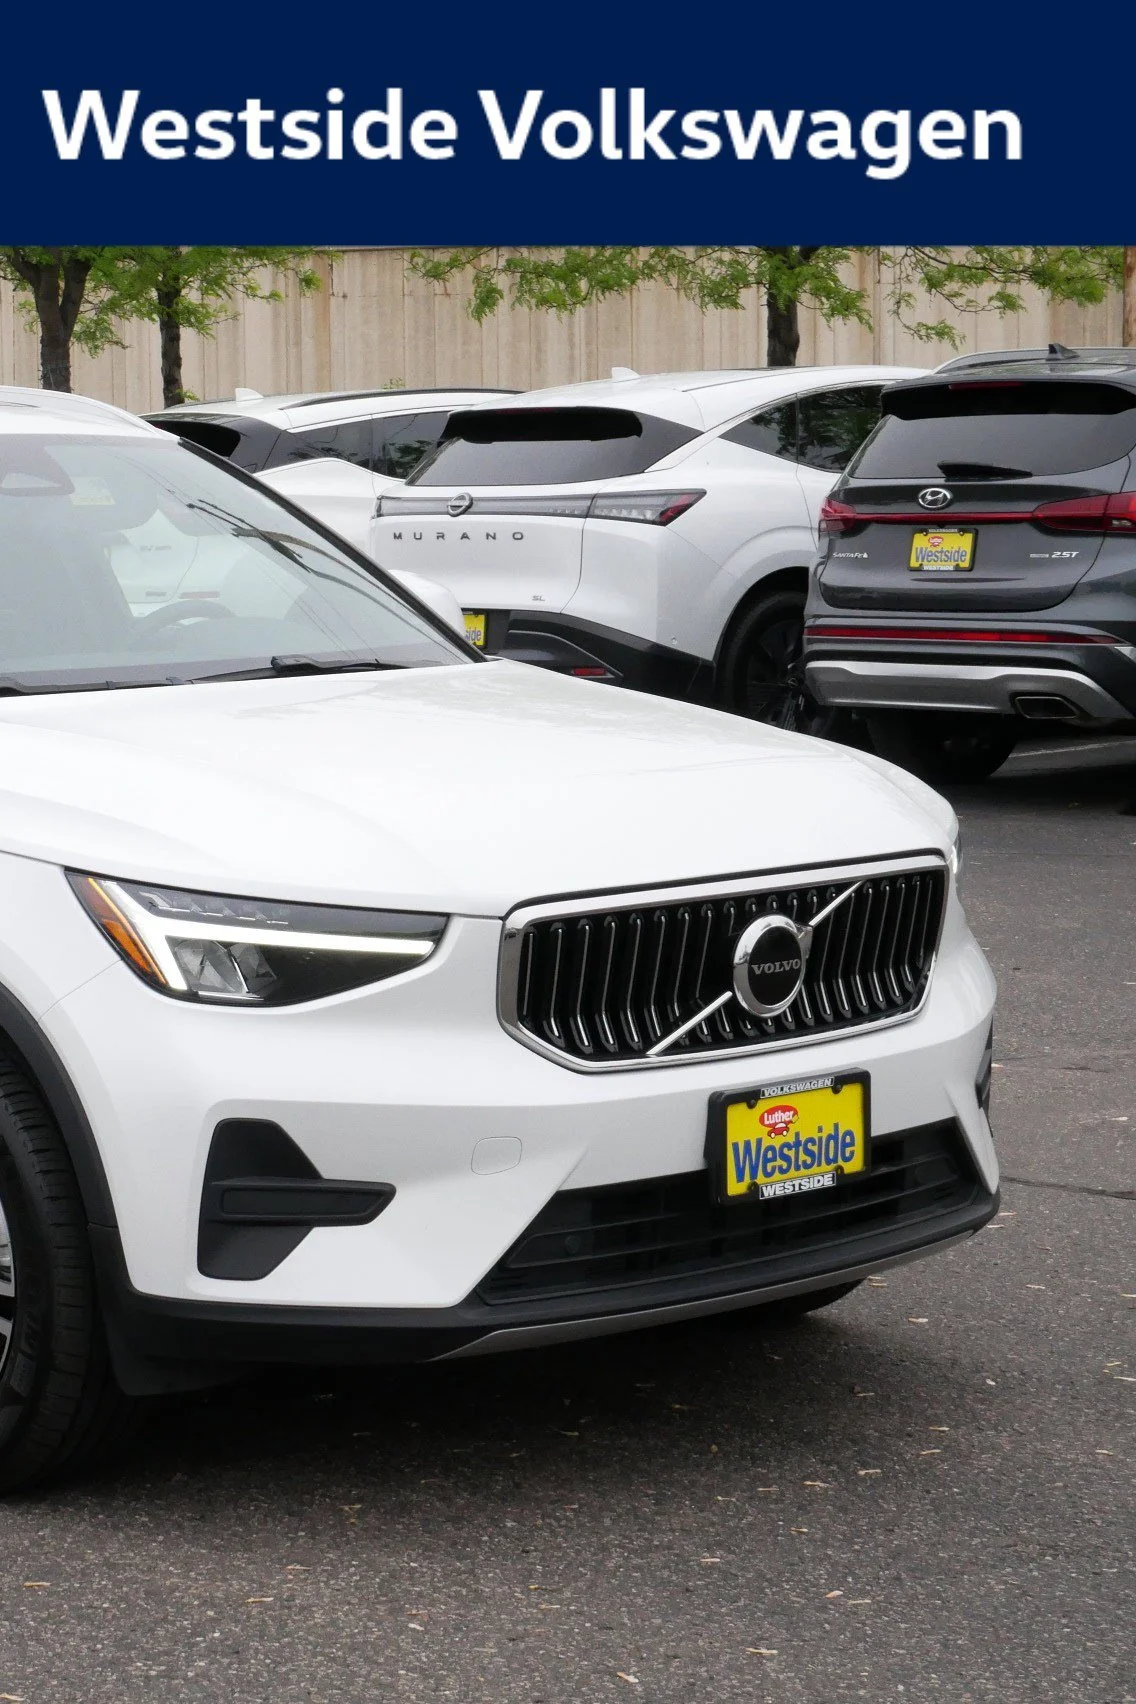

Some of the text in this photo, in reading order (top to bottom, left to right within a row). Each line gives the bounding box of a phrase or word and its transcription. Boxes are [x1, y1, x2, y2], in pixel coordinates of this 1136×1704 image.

[393, 531, 525, 541] MURANO
[915, 546, 968, 563] Westside
[751, 958, 801, 975] VOLVO
[764, 1078, 832, 1097] VOLKSWAGEN
[764, 1109, 795, 1125] Luther
[732, 1123, 855, 1183] Westside
[762, 1174, 834, 1197] WESTSIDE
